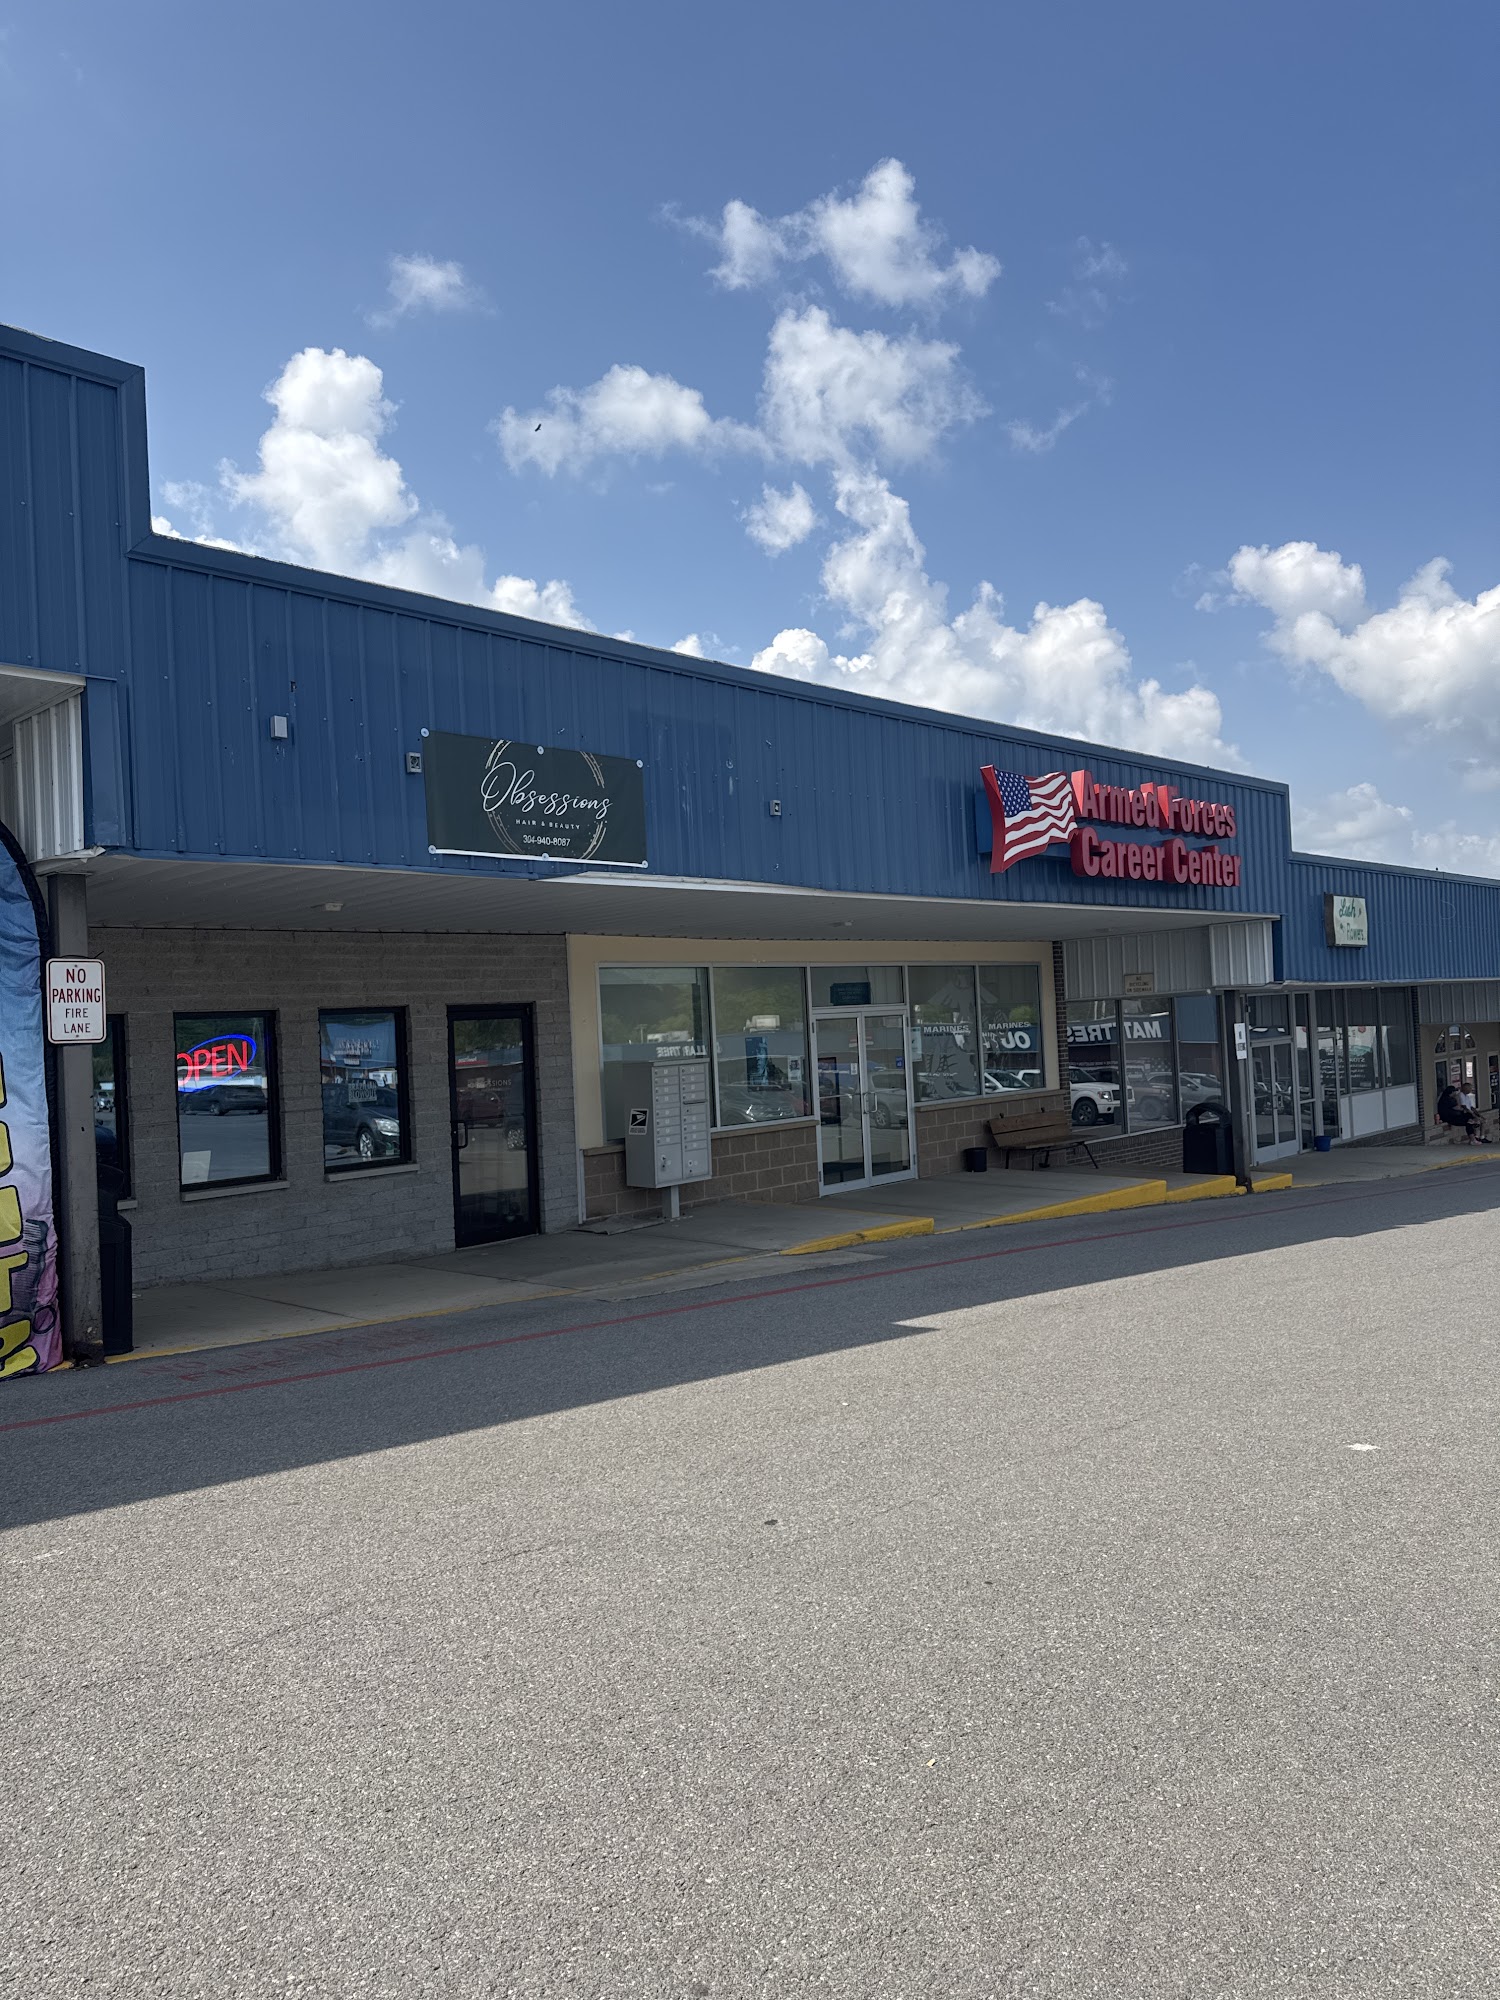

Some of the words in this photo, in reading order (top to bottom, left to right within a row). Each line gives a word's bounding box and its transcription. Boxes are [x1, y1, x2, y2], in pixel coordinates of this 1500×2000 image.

[480, 761, 613, 820] Obsessions
[1071, 769, 1160, 829] Armed
[1159, 785, 1236, 838] Forces
[515, 818, 537, 826] HAIR
[548, 821, 580, 830] BEAUTY
[1071, 826, 1166, 881] Career
[1164, 837, 1242, 887] Center
[66, 968, 87, 984] NO
[52, 988, 101, 1004] PARKING
[65, 1007, 89, 1018] FIRE
[63, 1022, 91, 1034] LANE
[923, 1024, 970, 1033] MARINES
[988, 1021, 1031, 1030] MARINES
[177, 1040, 248, 1087] OPEN
